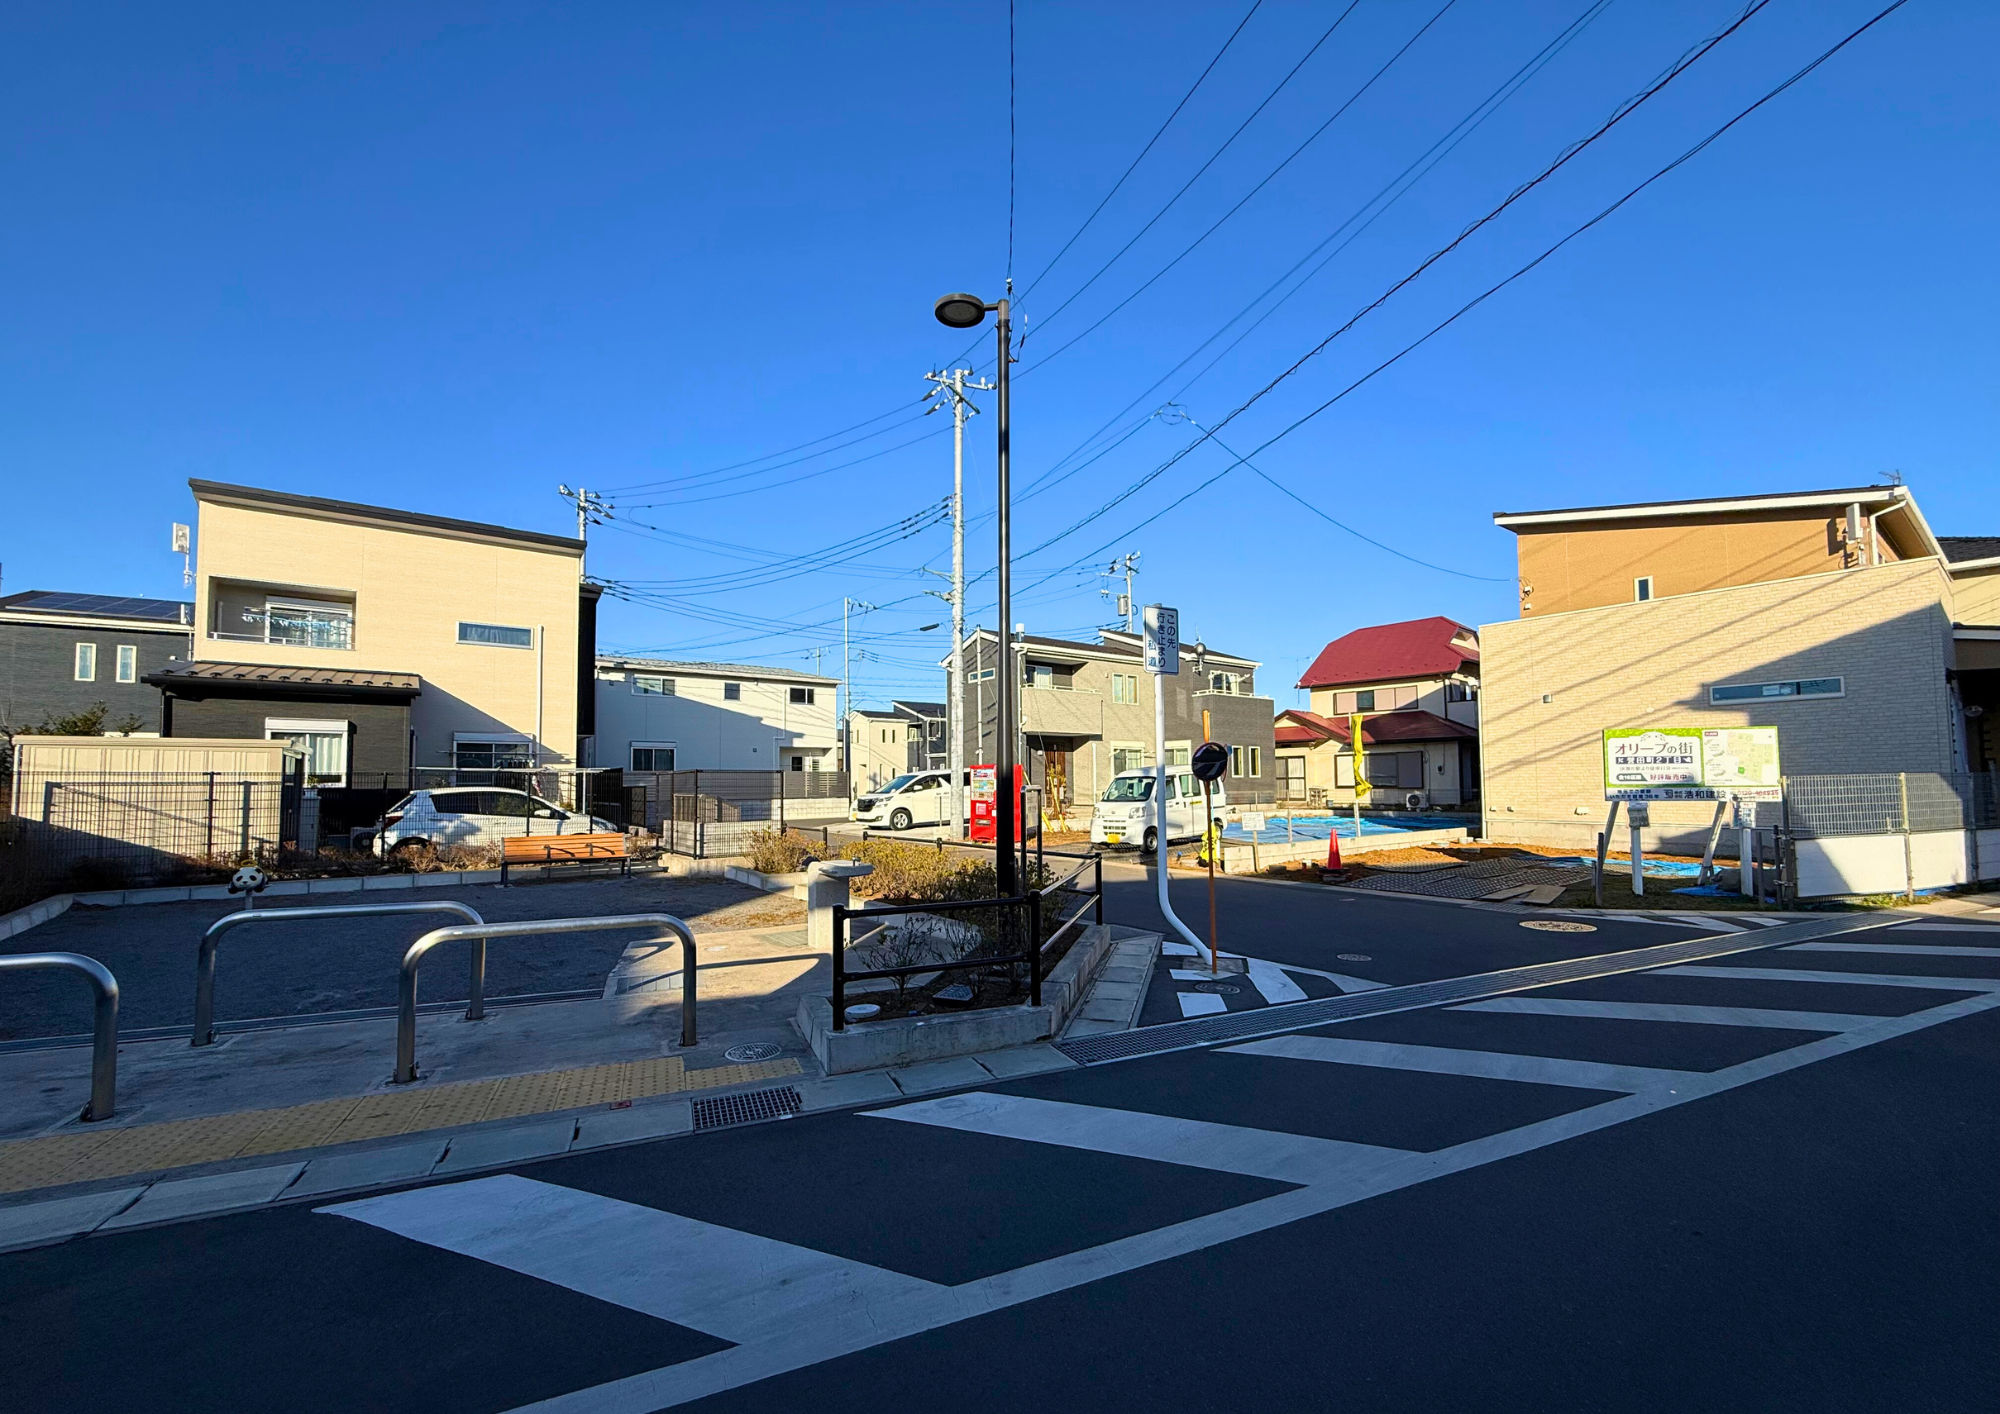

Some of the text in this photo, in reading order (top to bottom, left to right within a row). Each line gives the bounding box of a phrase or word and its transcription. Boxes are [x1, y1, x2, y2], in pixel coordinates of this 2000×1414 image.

[1157, 612, 1166, 668] 行き止まり
[1167, 614, 1176, 649] この先
[1148, 640, 1157, 667] 私道
[1615, 742, 1693, 755] オリーブの街
[1684, 789, 1726, 799] 浩和建設
